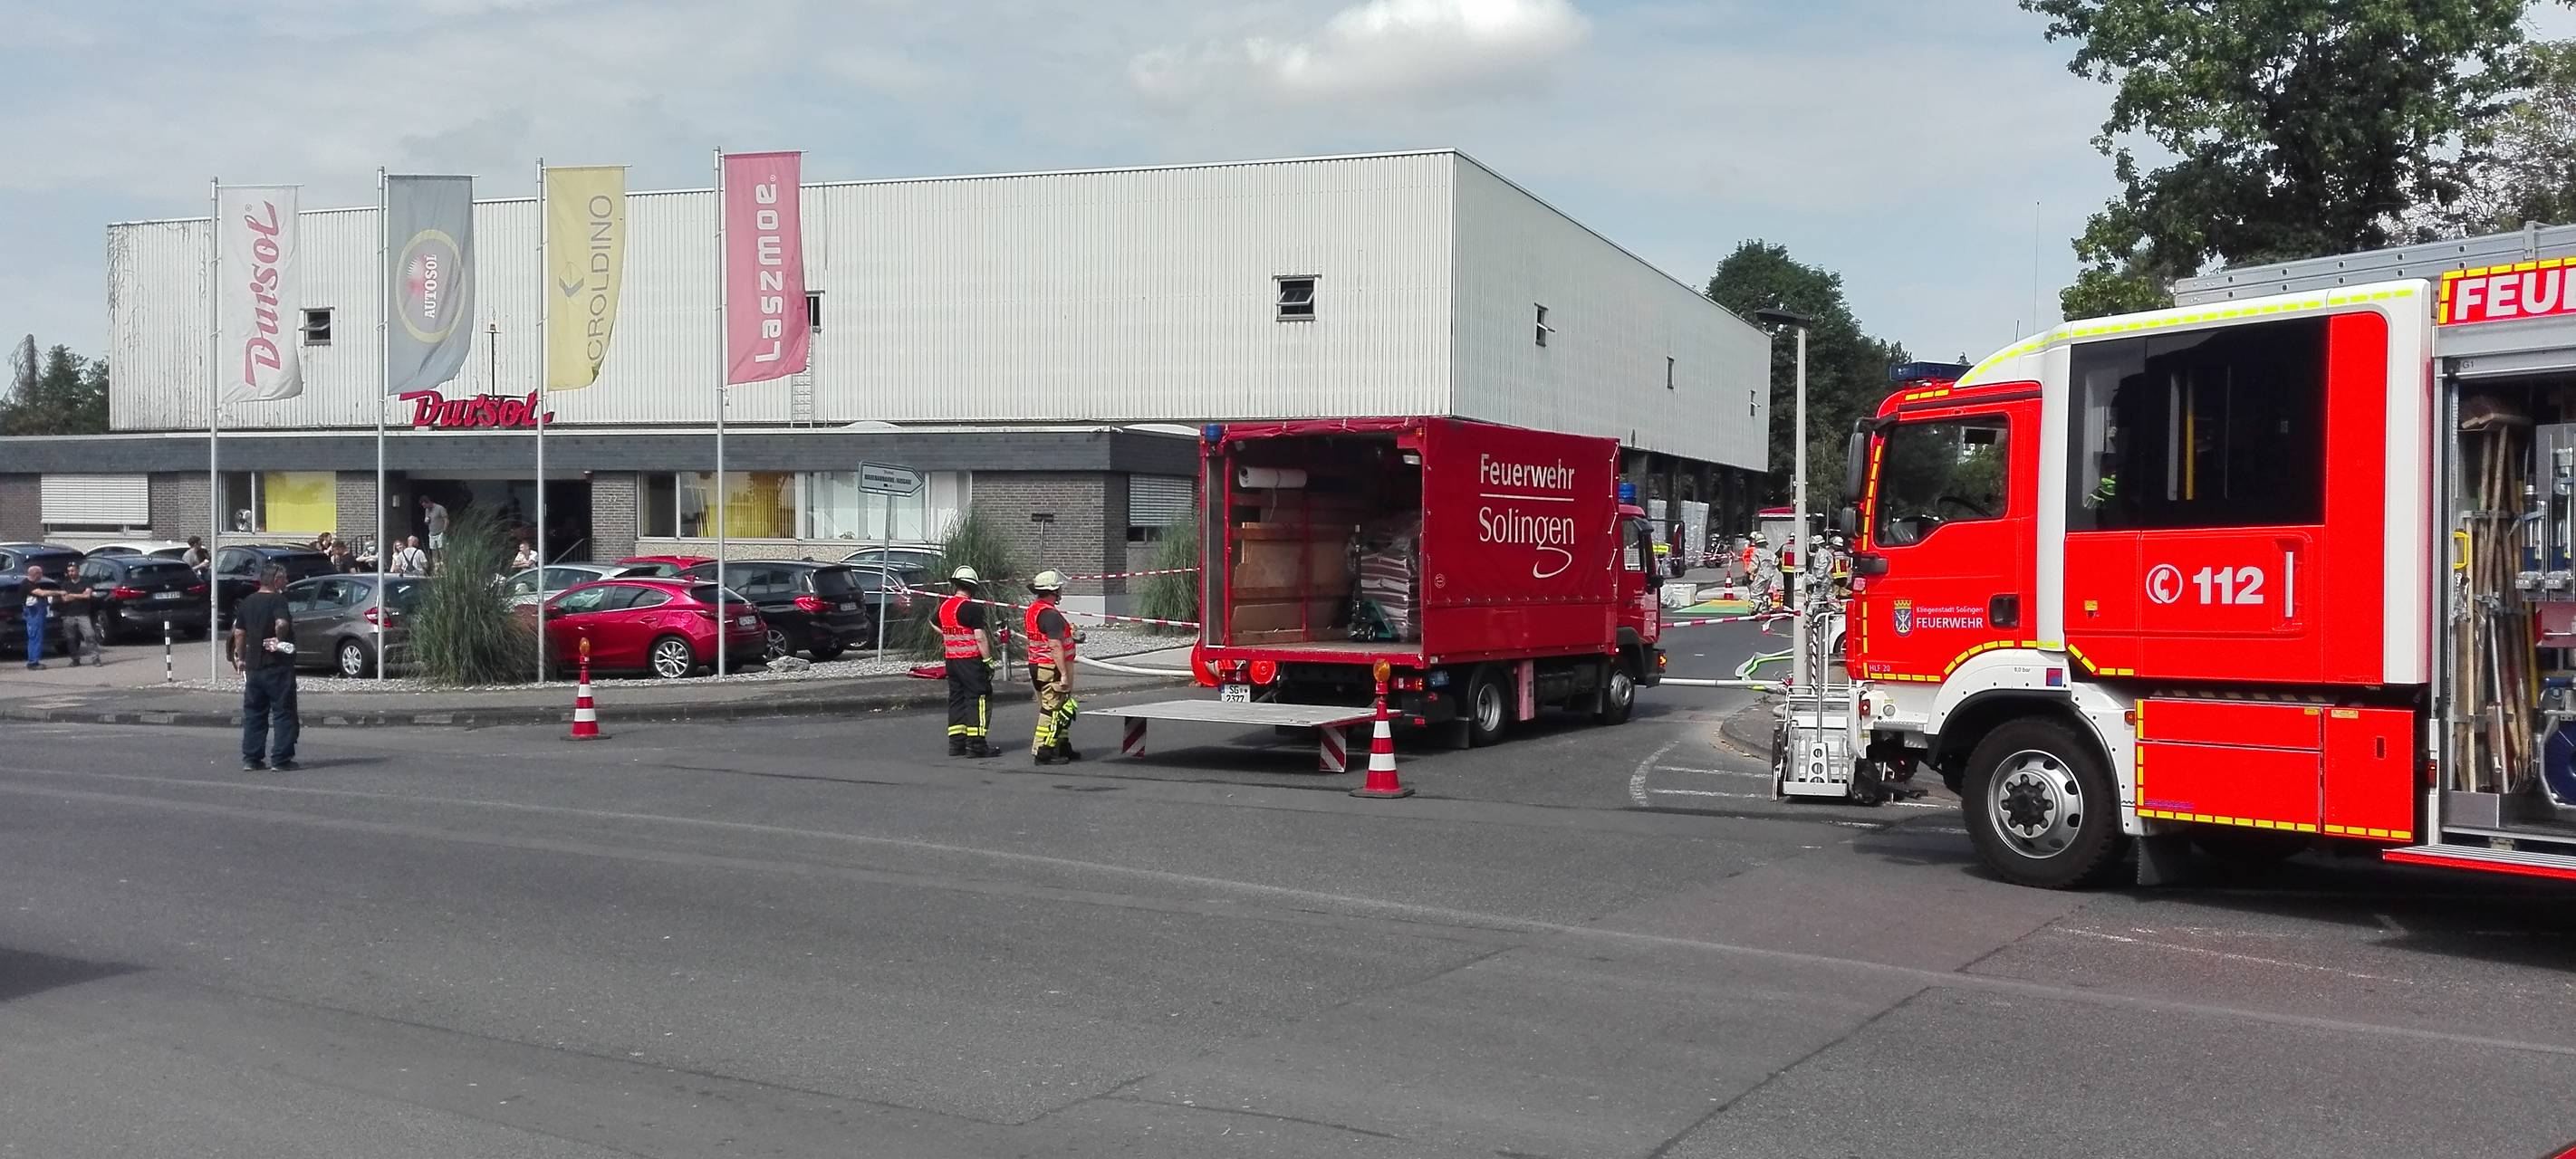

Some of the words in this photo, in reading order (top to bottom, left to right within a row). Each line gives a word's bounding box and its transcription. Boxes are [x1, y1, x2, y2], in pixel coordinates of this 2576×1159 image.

[424, 254, 438, 319] AUTOSOL
[587, 195, 613, 362] CROLDINO
[399, 388, 555, 426] Dursol
[1480, 453, 1575, 490] Feuerwehr
[1479, 506, 1575, 579] Solingen
[2192, 566, 2264, 605] 112
[1916, 606, 1955, 615] Klingenstadt
[1956, 605, 1984, 615] Solingen
[1916, 617, 1984, 628] FEUERWEHR
[1869, 664, 1881, 672] HLF
[1882, 664, 1890, 672] 20
[1229, 685, 1239, 694] SG
